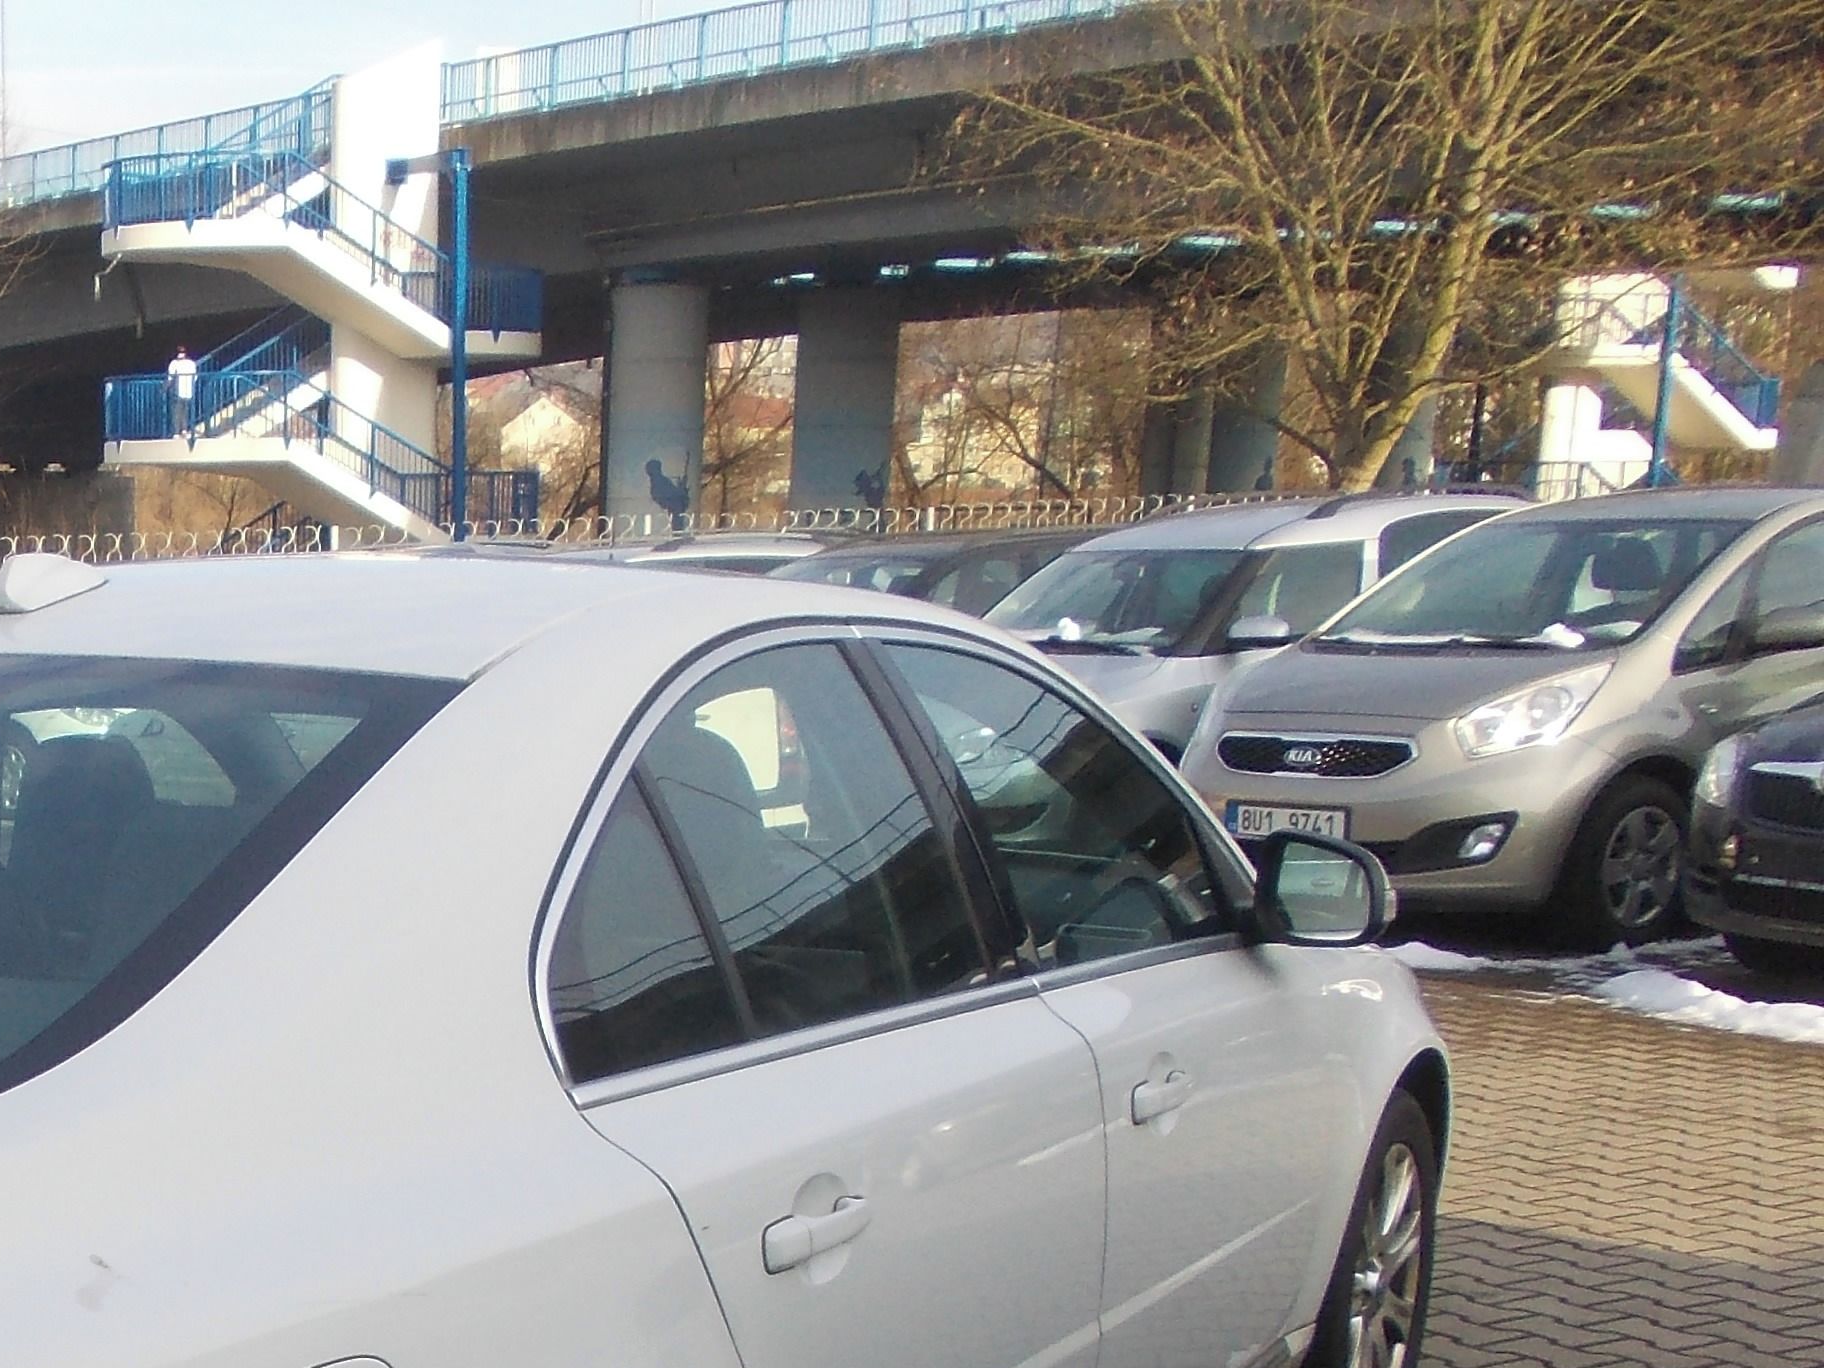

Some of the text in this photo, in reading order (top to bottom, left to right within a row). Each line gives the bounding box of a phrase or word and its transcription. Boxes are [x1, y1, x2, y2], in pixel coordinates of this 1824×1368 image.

[1287, 749, 1313, 762] KIA
[1242, 809, 1274, 833] 8U1
[1288, 812, 1334, 836] 9741
